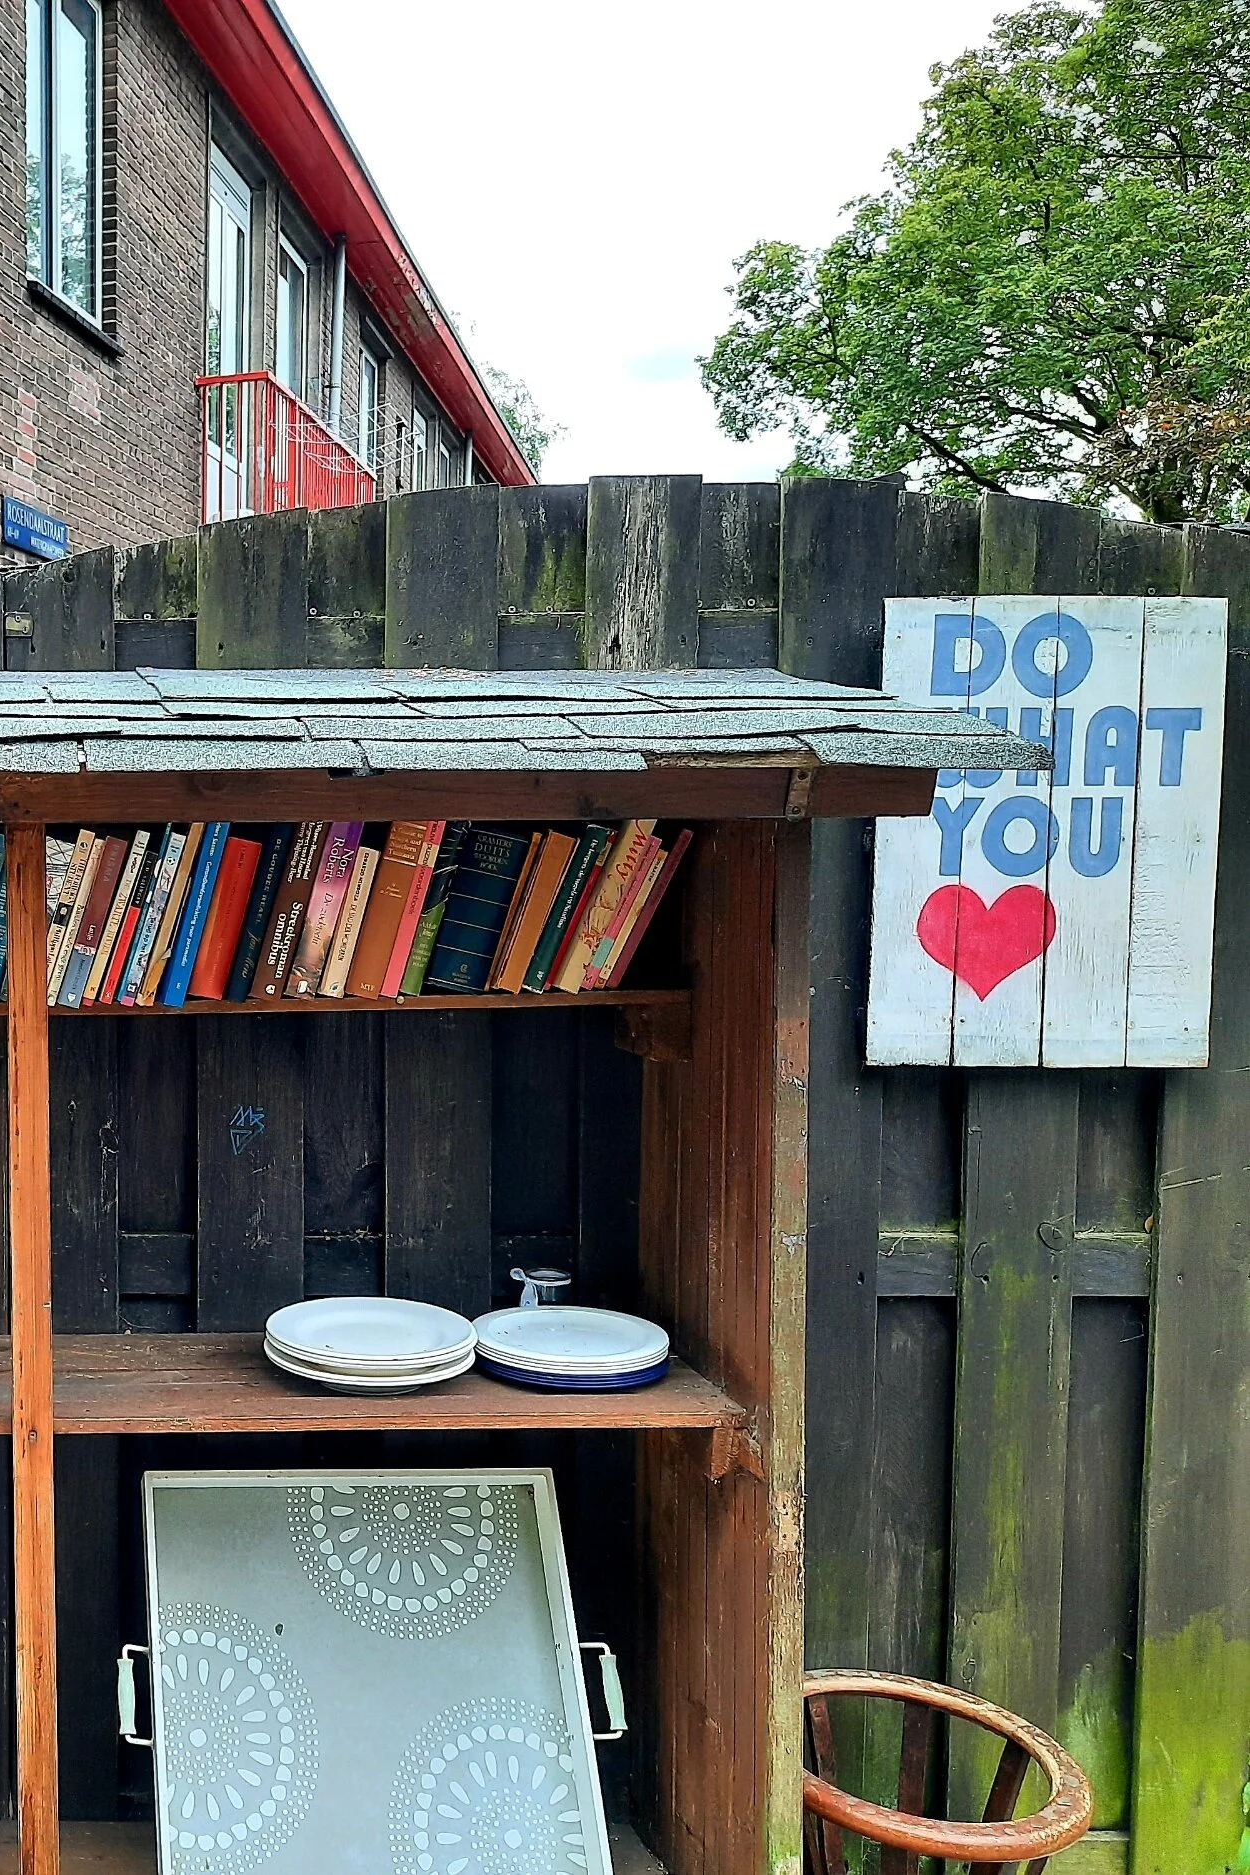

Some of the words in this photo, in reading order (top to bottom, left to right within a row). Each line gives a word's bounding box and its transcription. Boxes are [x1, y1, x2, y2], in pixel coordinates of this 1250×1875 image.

[7, 503, 65, 544] ROSENDAALSTRAAT
[929, 612, 1094, 699] DO
[322, 836, 346, 884] Roberts
[474, 842, 511, 857] DUITS
[616, 819, 648, 880] Milly
[930, 795, 1125, 878] YOU
[333, 847, 355, 879] Nora
[322, 892, 335, 907] De
[267, 912, 287, 966] omnibus
[274, 901, 304, 979] Streekroman
